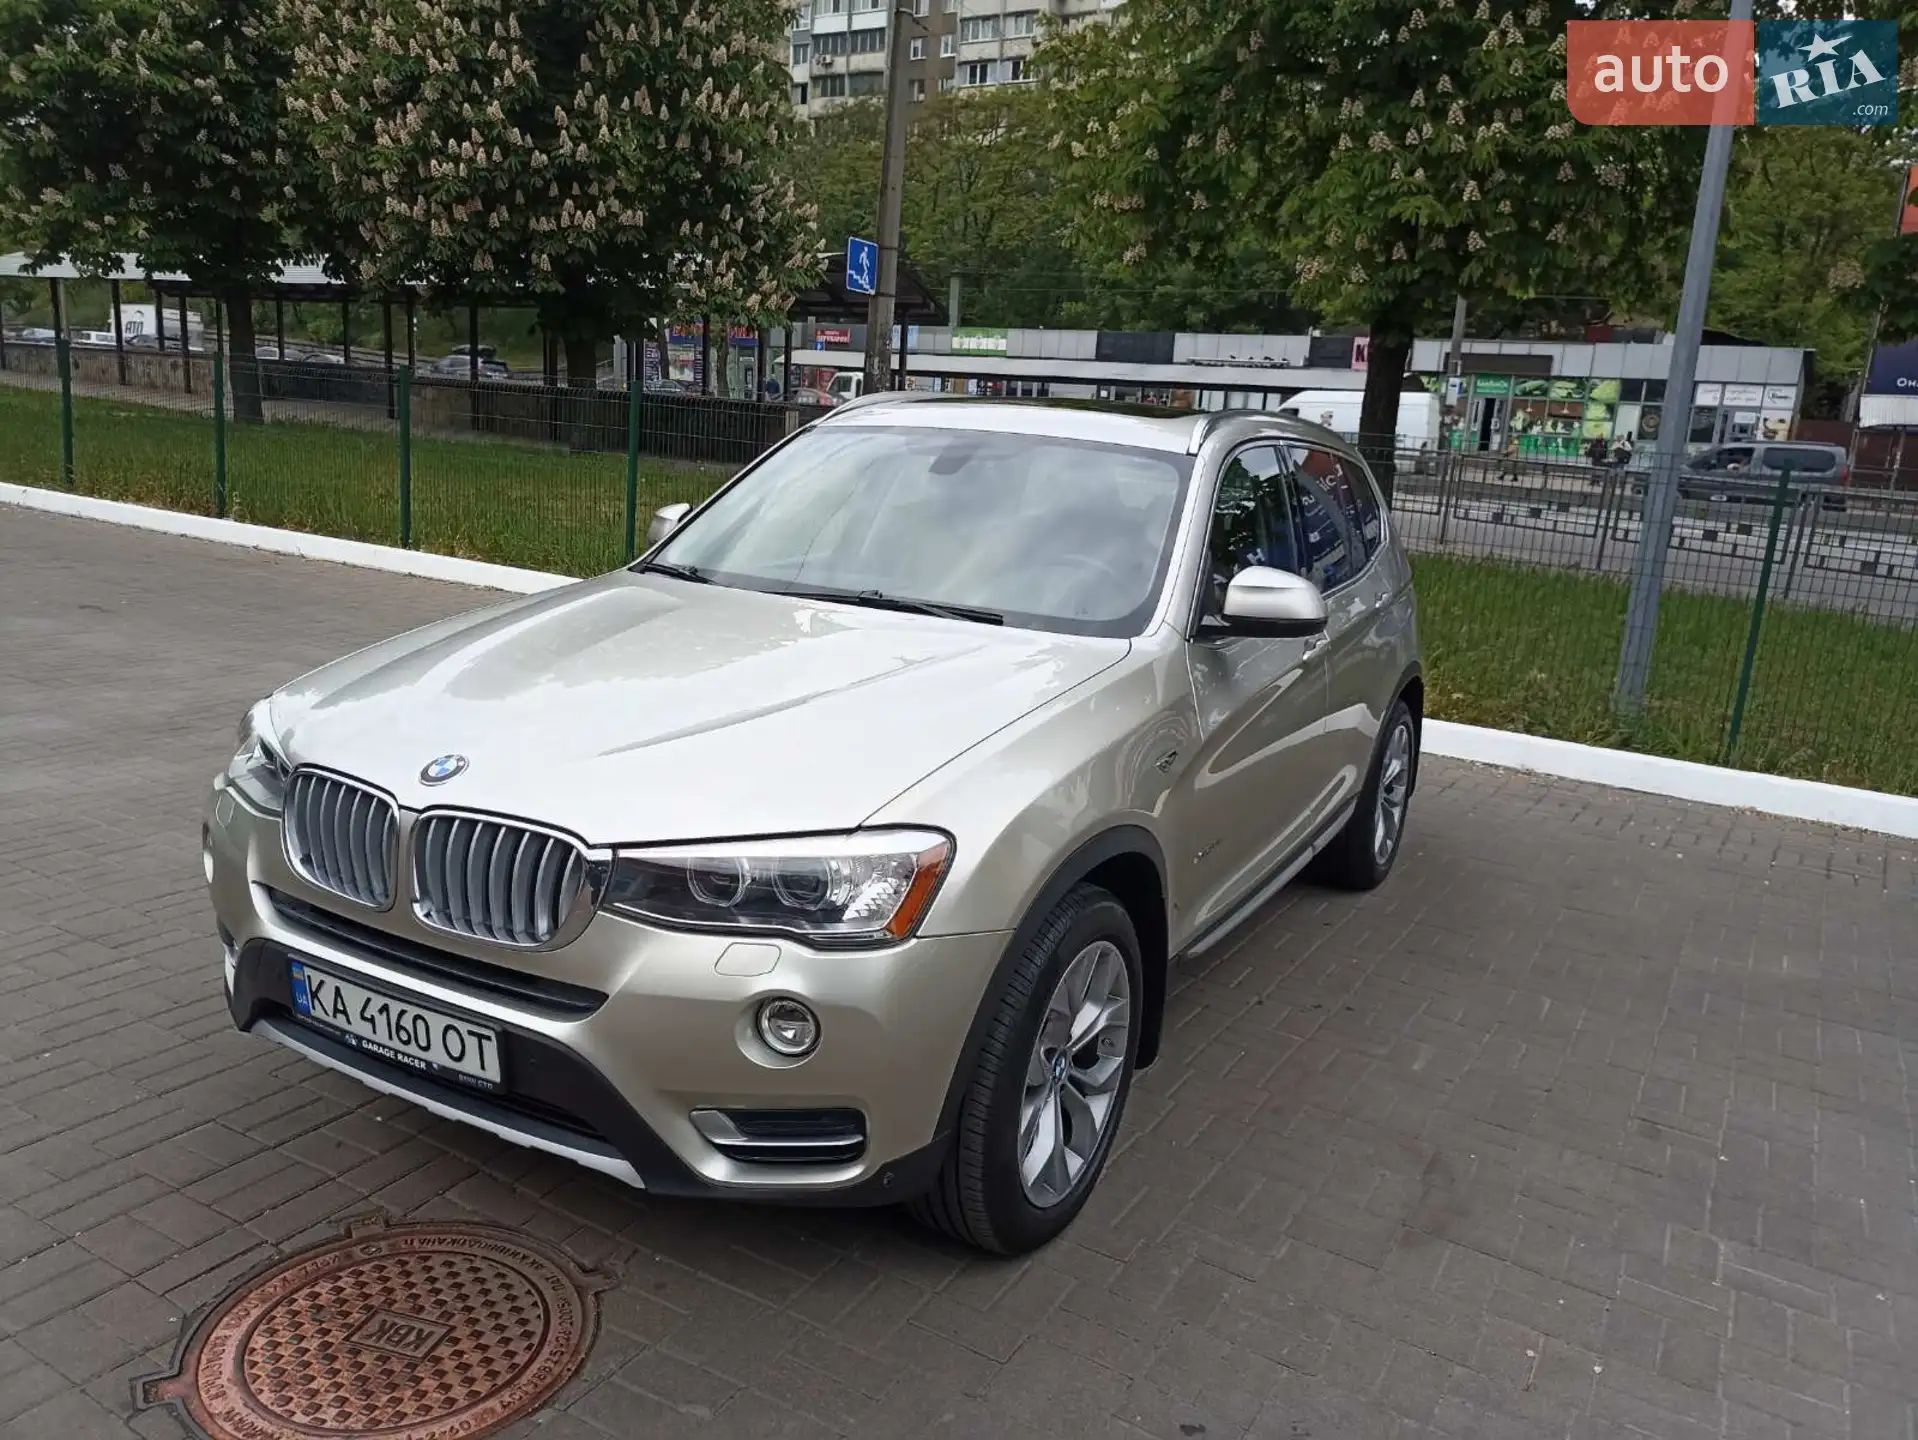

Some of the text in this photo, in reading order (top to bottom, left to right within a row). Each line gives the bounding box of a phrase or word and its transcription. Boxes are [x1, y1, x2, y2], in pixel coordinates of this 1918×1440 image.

[296, 993, 309, 1006] UA
[307, 974, 352, 1026] KA
[359, 997, 431, 1052] 4160
[442, 1023, 493, 1071] OT
[361, 1039, 427, 1071] GARAGE RACER
